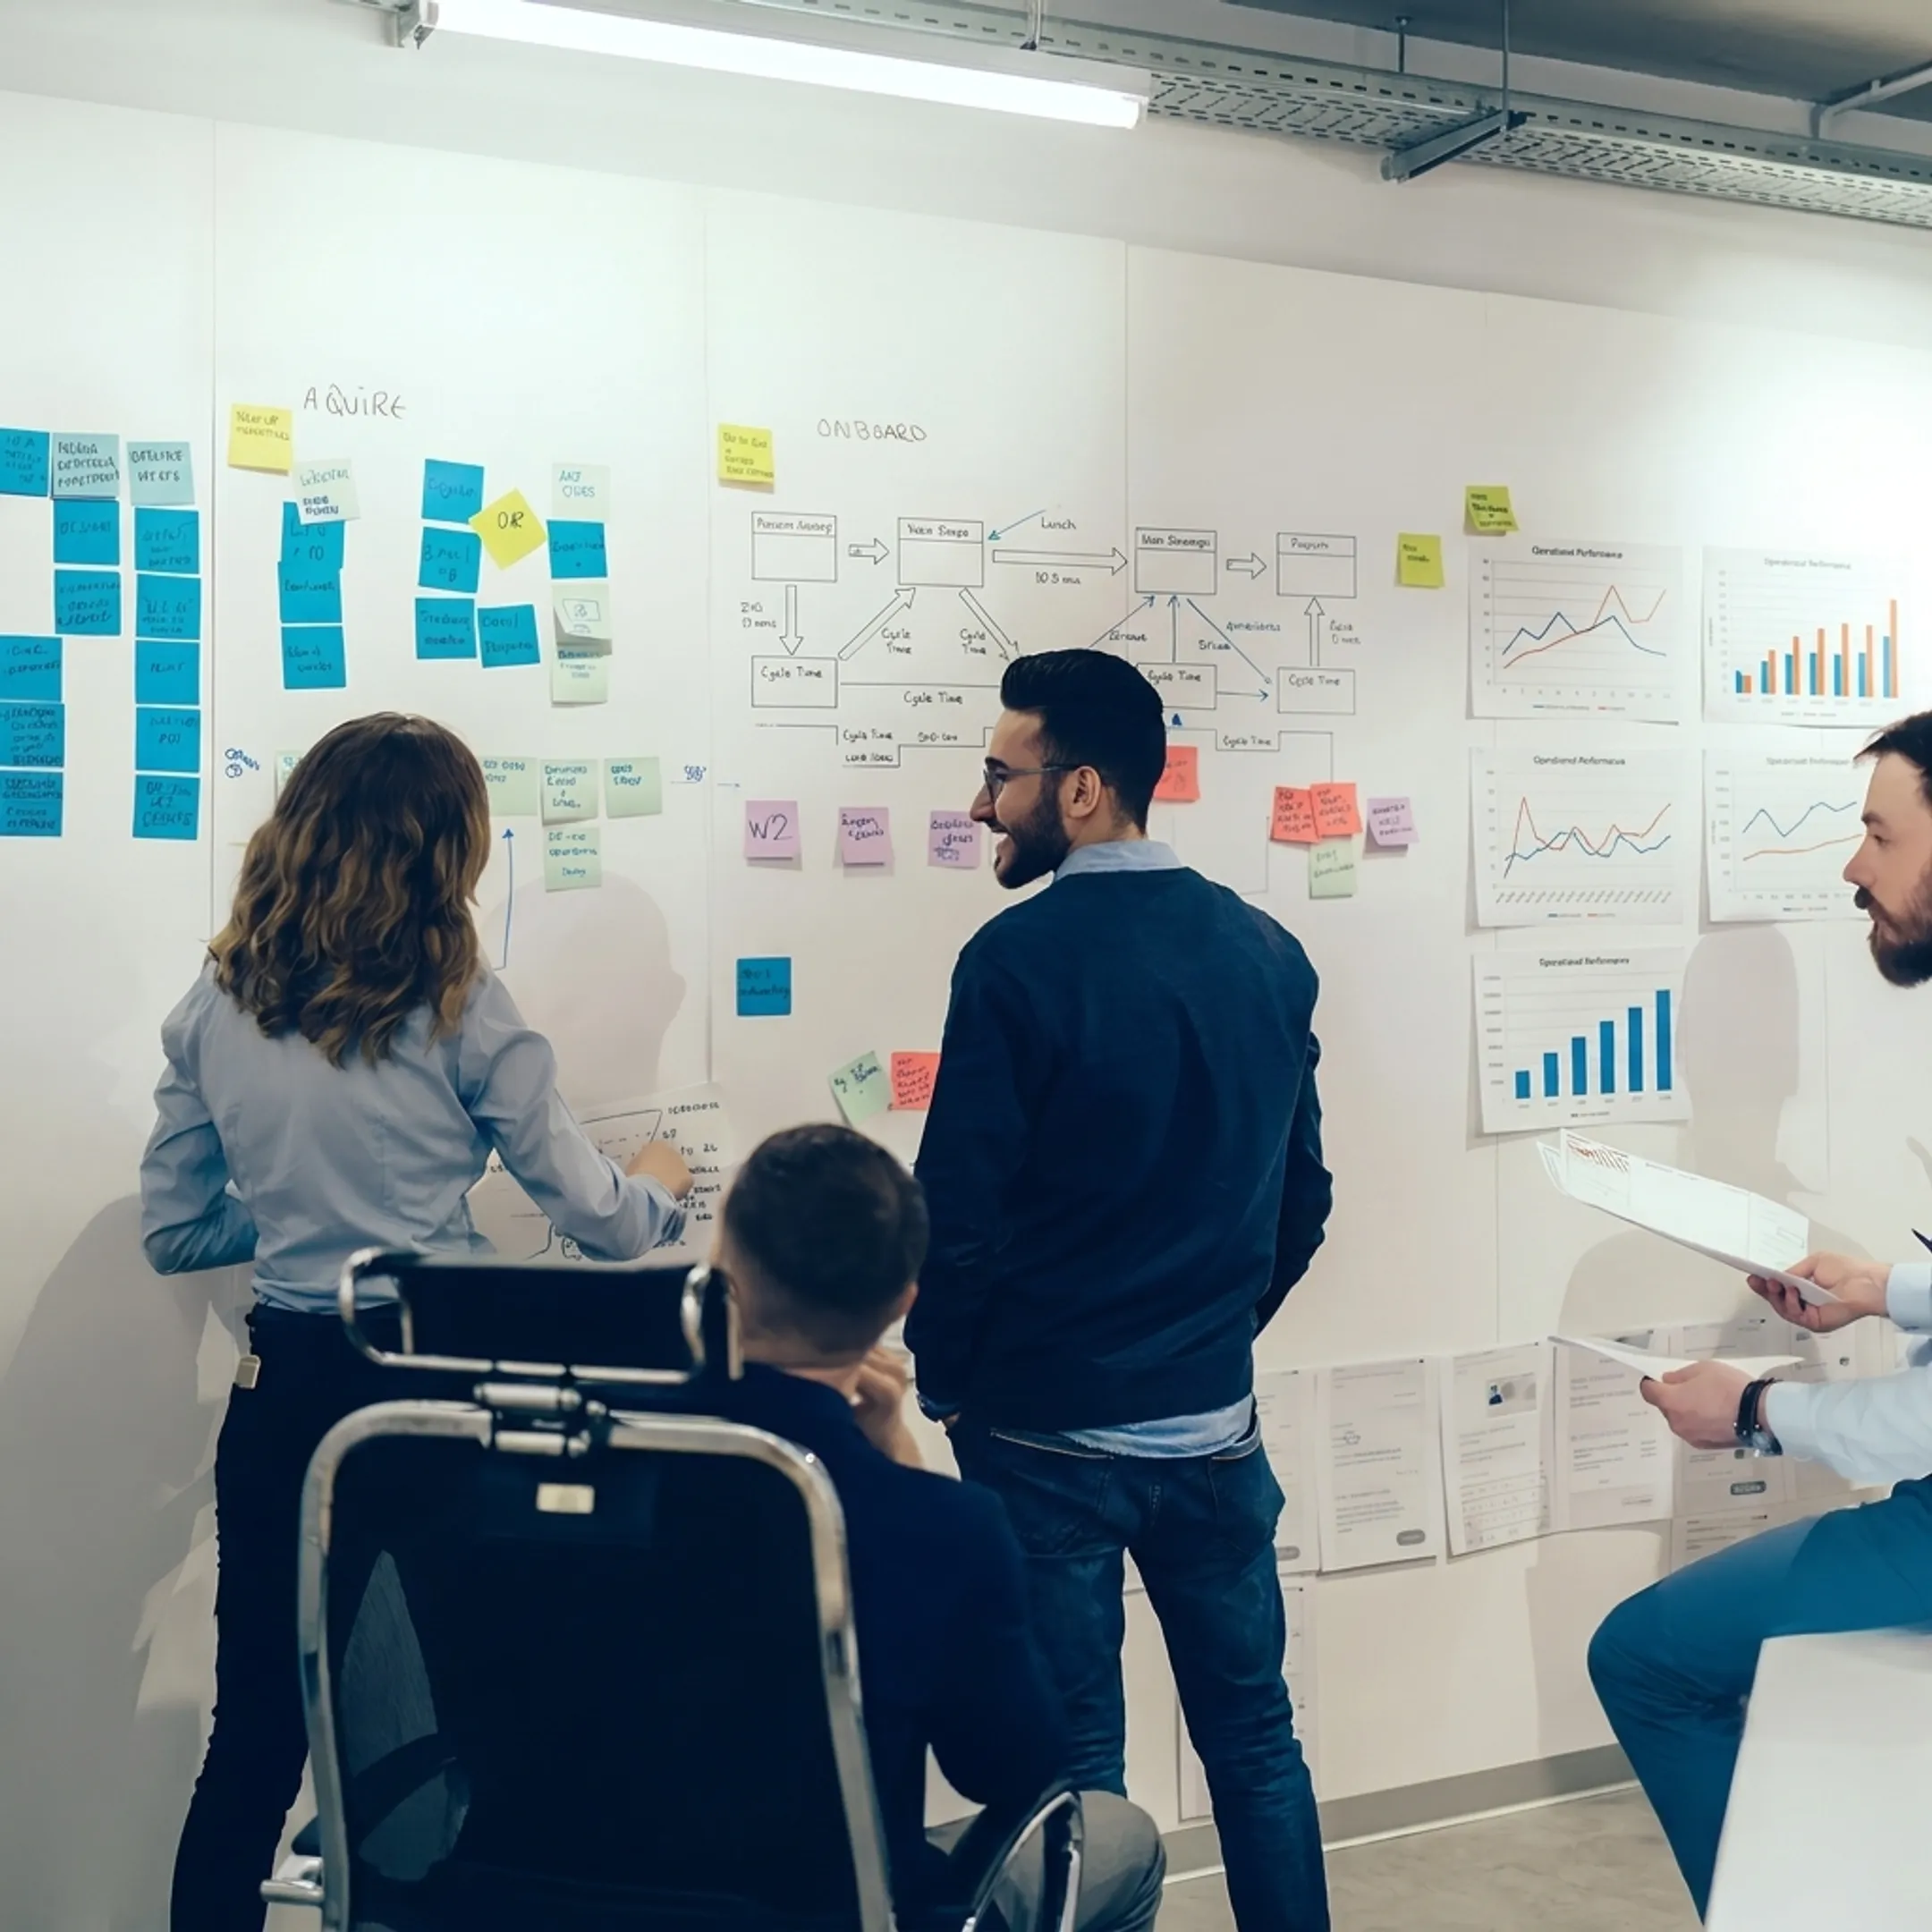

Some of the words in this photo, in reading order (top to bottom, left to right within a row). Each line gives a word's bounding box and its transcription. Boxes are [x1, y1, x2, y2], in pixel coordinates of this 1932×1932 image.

[817, 419, 928, 442] ONBOARD
[497, 512, 524, 529] OR
[1041, 516, 1076, 530] Lunch
[748, 813, 792, 841] W2
